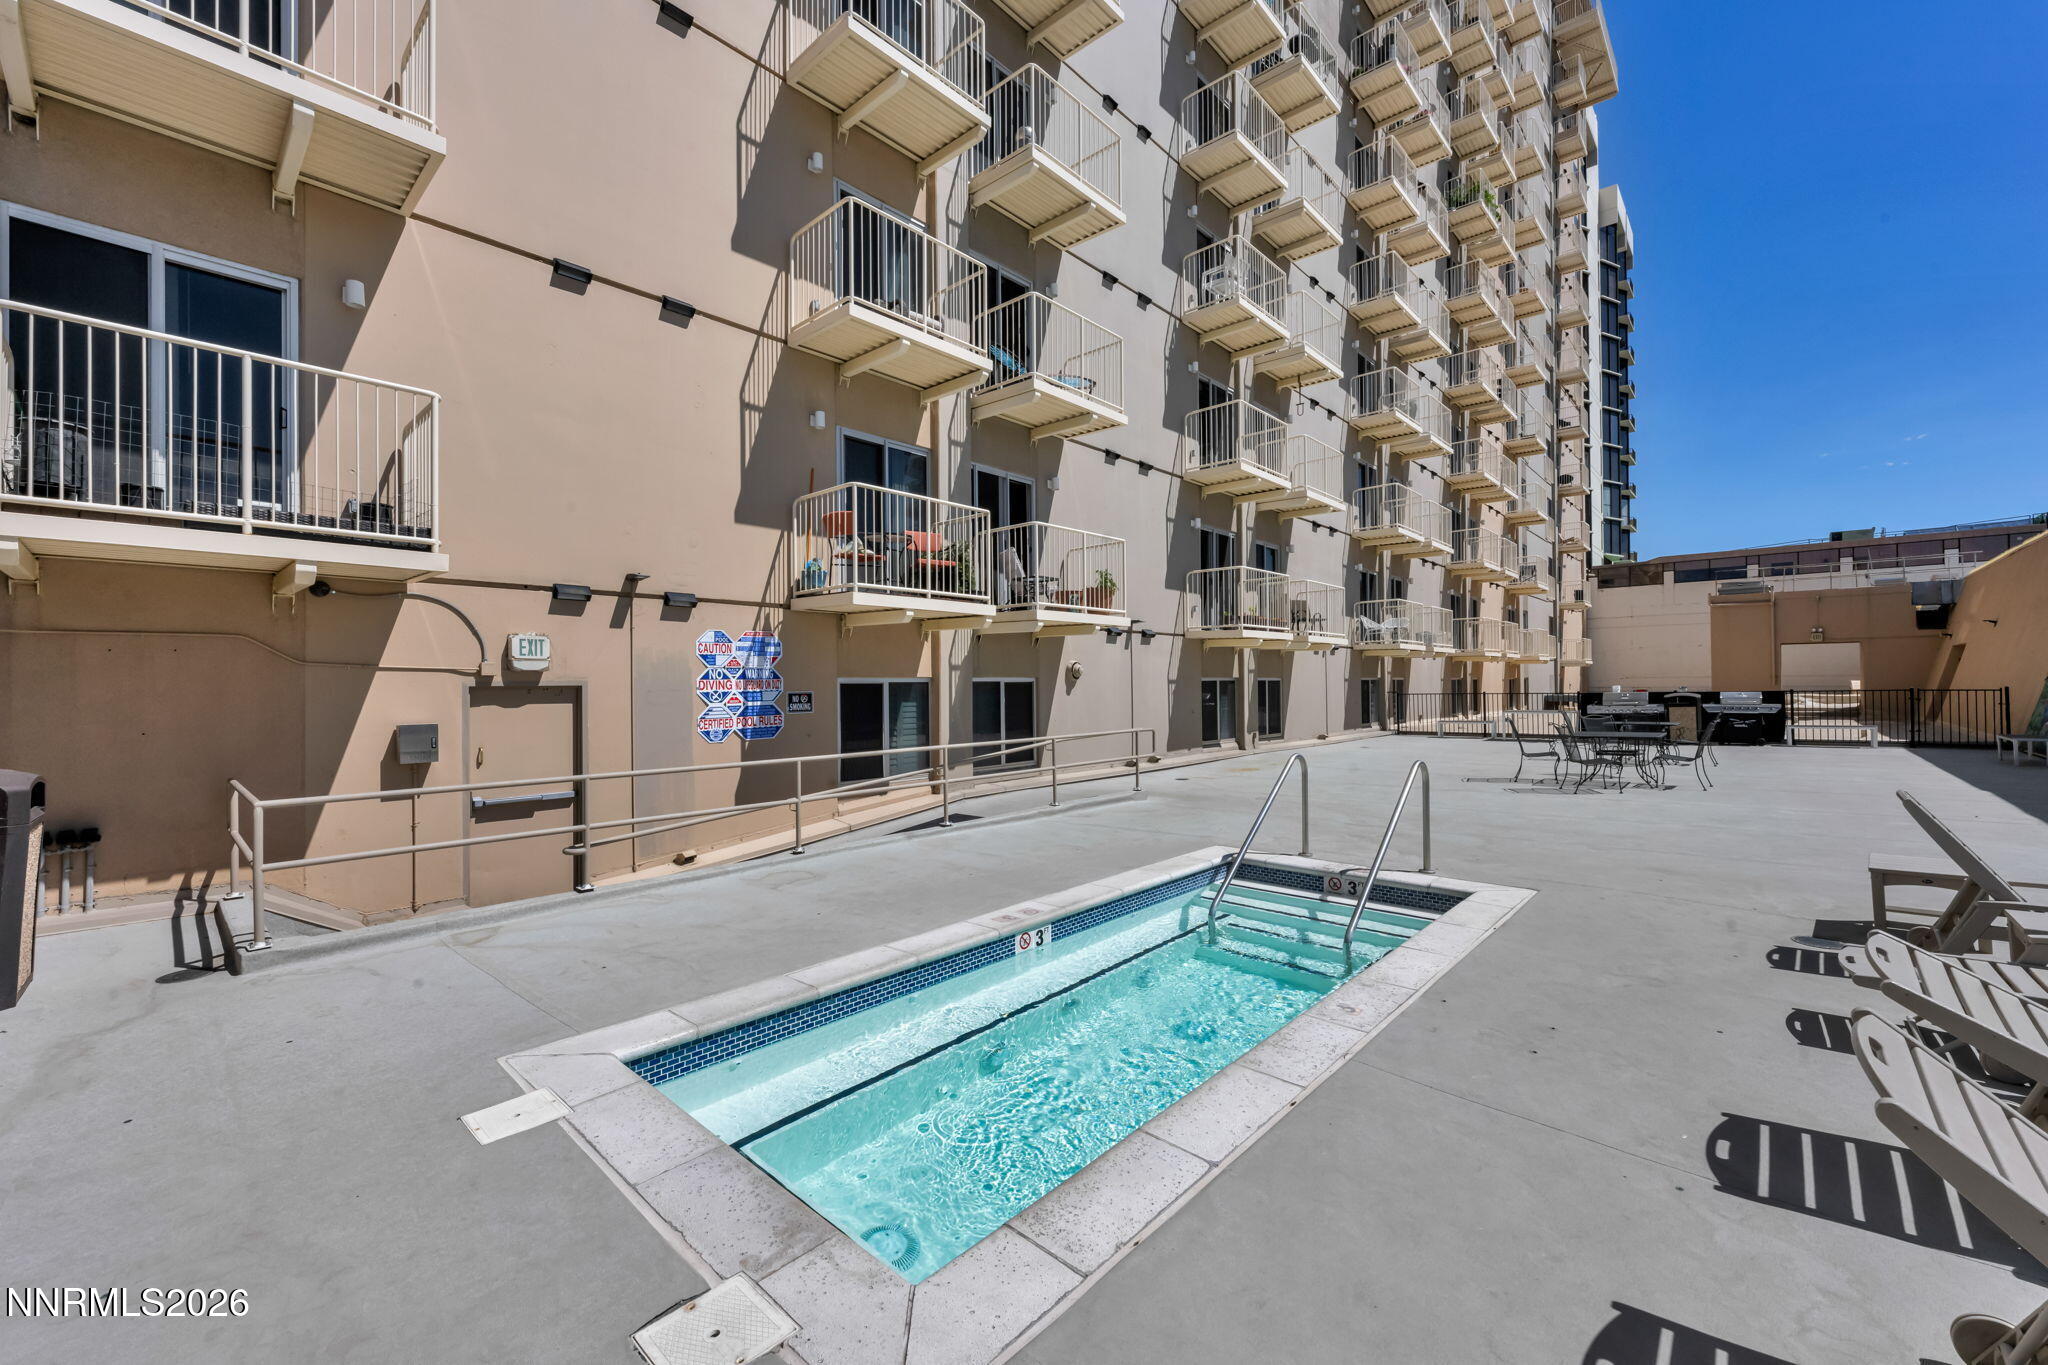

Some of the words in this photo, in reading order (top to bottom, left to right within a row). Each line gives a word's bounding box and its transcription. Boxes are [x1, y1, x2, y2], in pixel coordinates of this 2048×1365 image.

[519, 639, 544, 656] EXIT
[698, 643, 732, 654] CAUTION
[709, 669, 723, 679] NO
[745, 669, 774, 679] WARNING
[698, 680, 732, 690] DIVING
[698, 719, 733, 730] CERTIFIED
[736, 717, 757, 727] POOL
[759, 716, 782, 726] RULES
[1348, 881, 1357, 895] 3
[1036, 930, 1044, 946] 3
